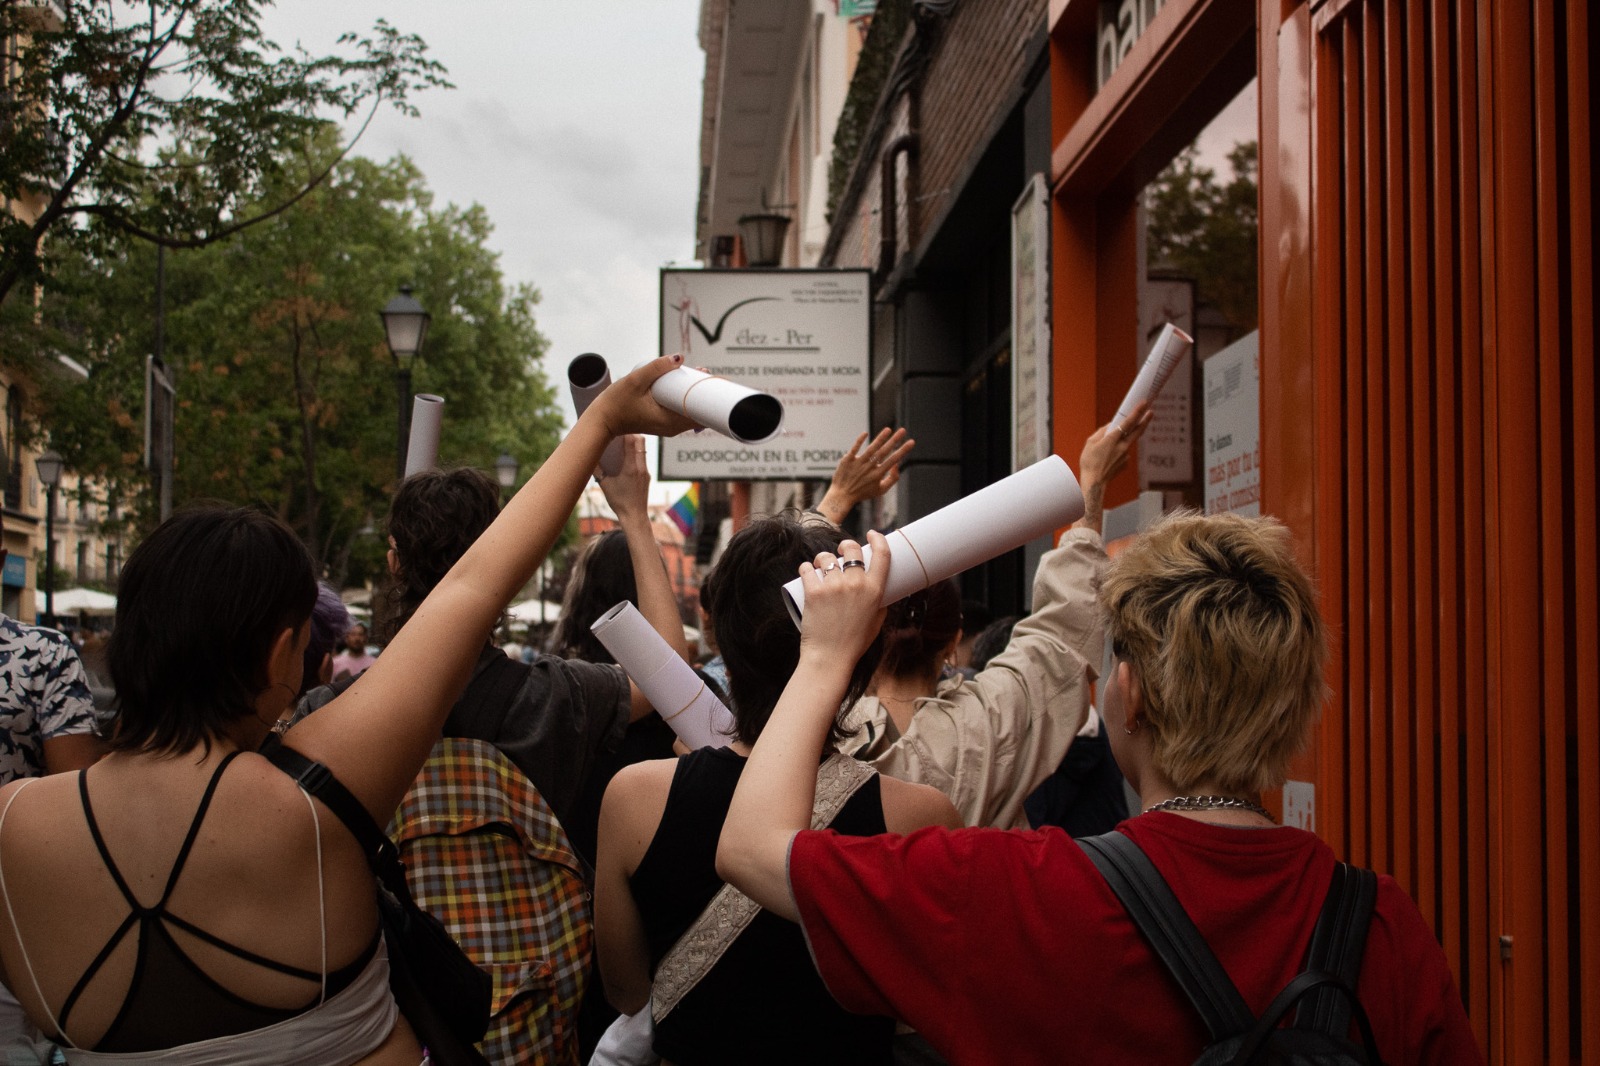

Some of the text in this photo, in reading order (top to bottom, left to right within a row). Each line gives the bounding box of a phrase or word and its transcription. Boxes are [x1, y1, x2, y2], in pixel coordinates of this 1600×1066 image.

[786, 329, 814, 345] Per
[748, 366, 759, 376] DE
[763, 364, 815, 376] ENSEÑANZA
[818, 366, 828, 376] DE
[832, 366, 862, 376] MODA
[677, 448, 847, 463] EXPOSICIÓN EN EL PORTA
